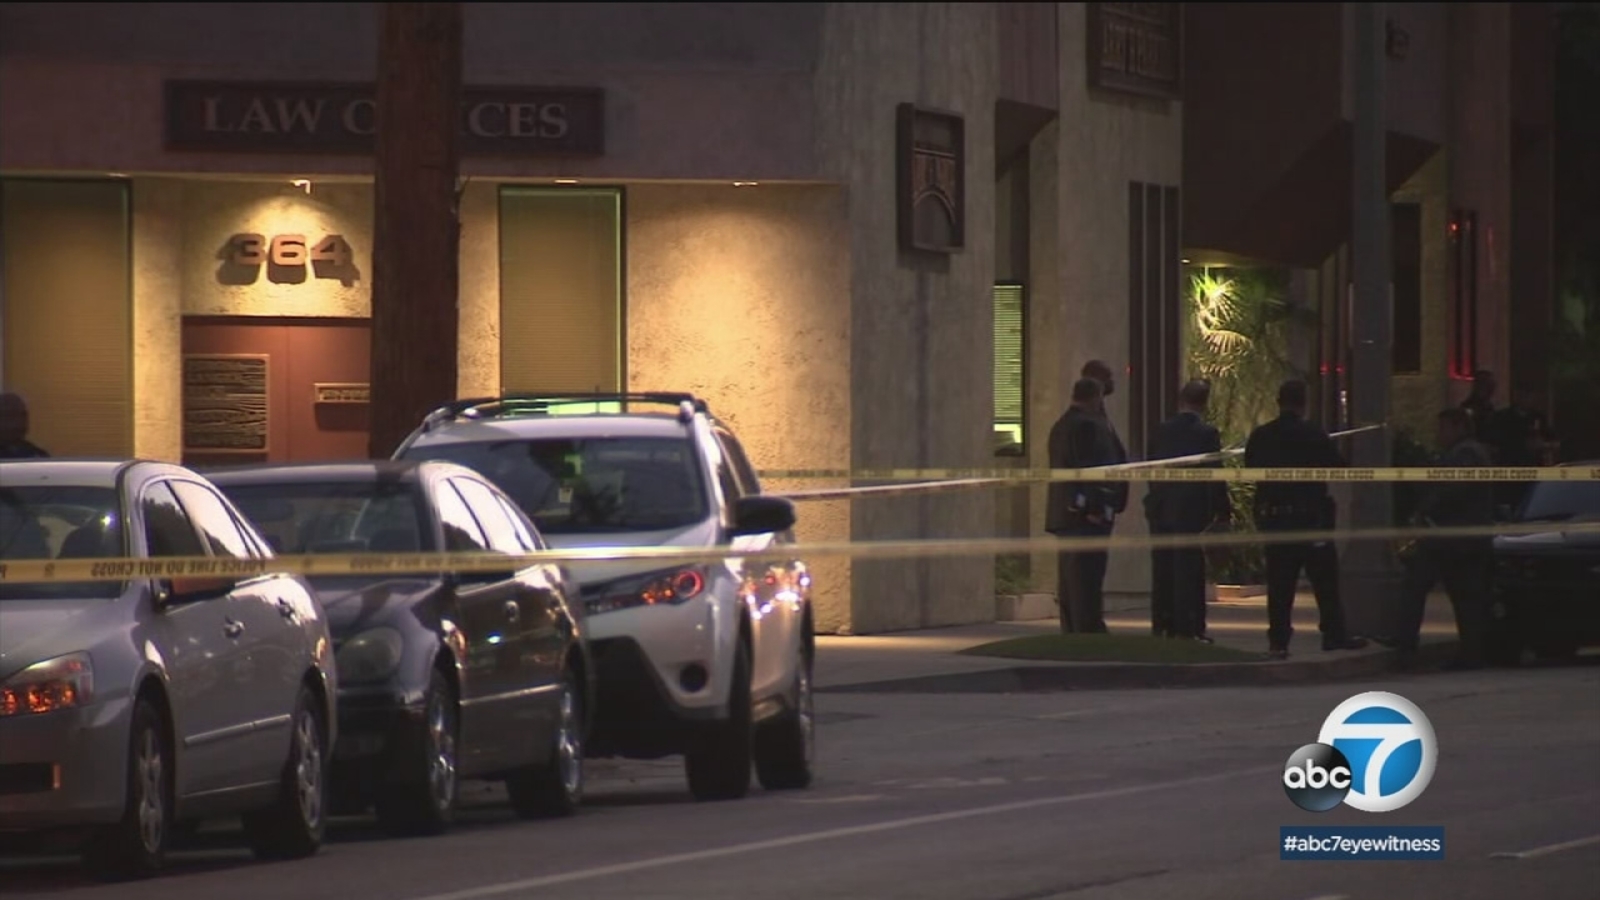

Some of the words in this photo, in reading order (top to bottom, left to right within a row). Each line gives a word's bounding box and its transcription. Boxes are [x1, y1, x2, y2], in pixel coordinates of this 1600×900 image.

[204, 98, 324, 133] LAW
[343, 99, 569, 138] OCES
[228, 233, 349, 266] 364
